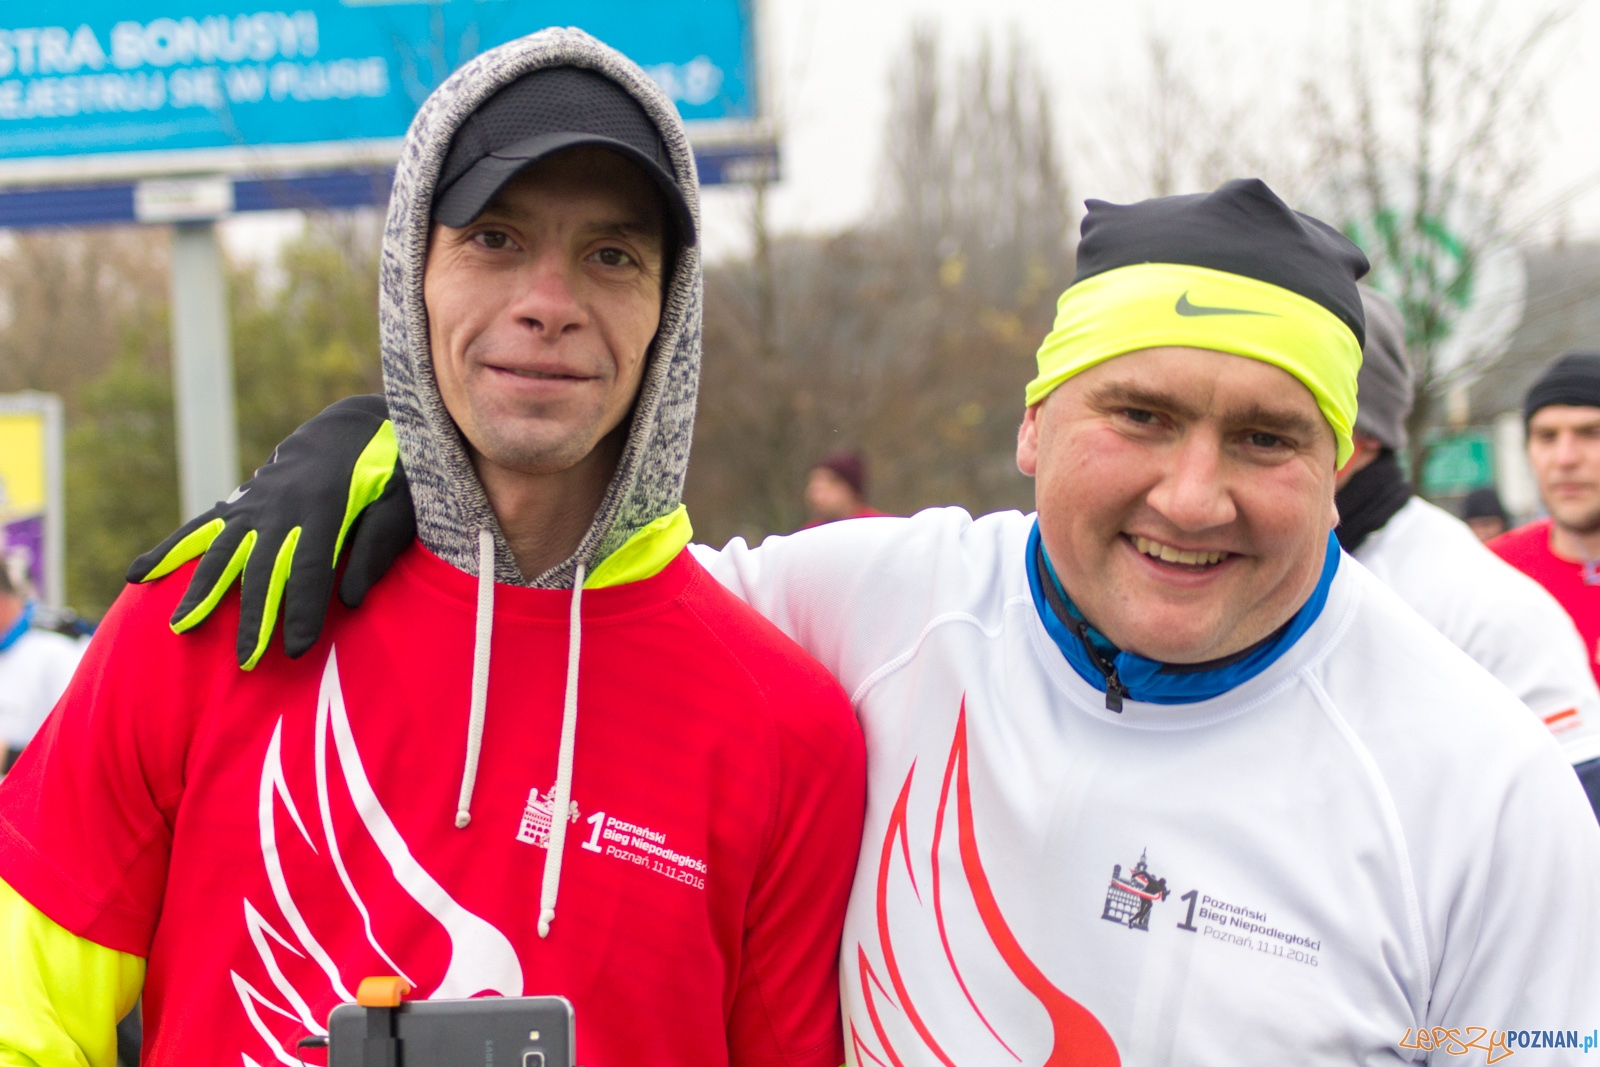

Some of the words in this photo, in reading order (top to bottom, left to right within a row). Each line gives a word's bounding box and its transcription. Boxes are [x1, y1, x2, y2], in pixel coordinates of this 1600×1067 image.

[109, 10, 319, 67] BONUSY!
[226, 63, 267, 102] W
[269, 57, 388, 101] PLUSIE
[581, 811, 606, 854] 1
[603, 828, 630, 846] Bieg
[606, 816, 666, 845] Poznański
[606, 845, 651, 869] Poznań,
[652, 860, 705, 890] 11.11.2016
[1177, 889, 1199, 933] 1
[1199, 908, 1227, 925] Bieg
[1230, 917, 1321, 951] Niepodległości
[1202, 895, 1267, 923] Poznański
[1204, 925, 1254, 950] Poznań,
[1257, 941, 1319, 967] 11.11.2016
